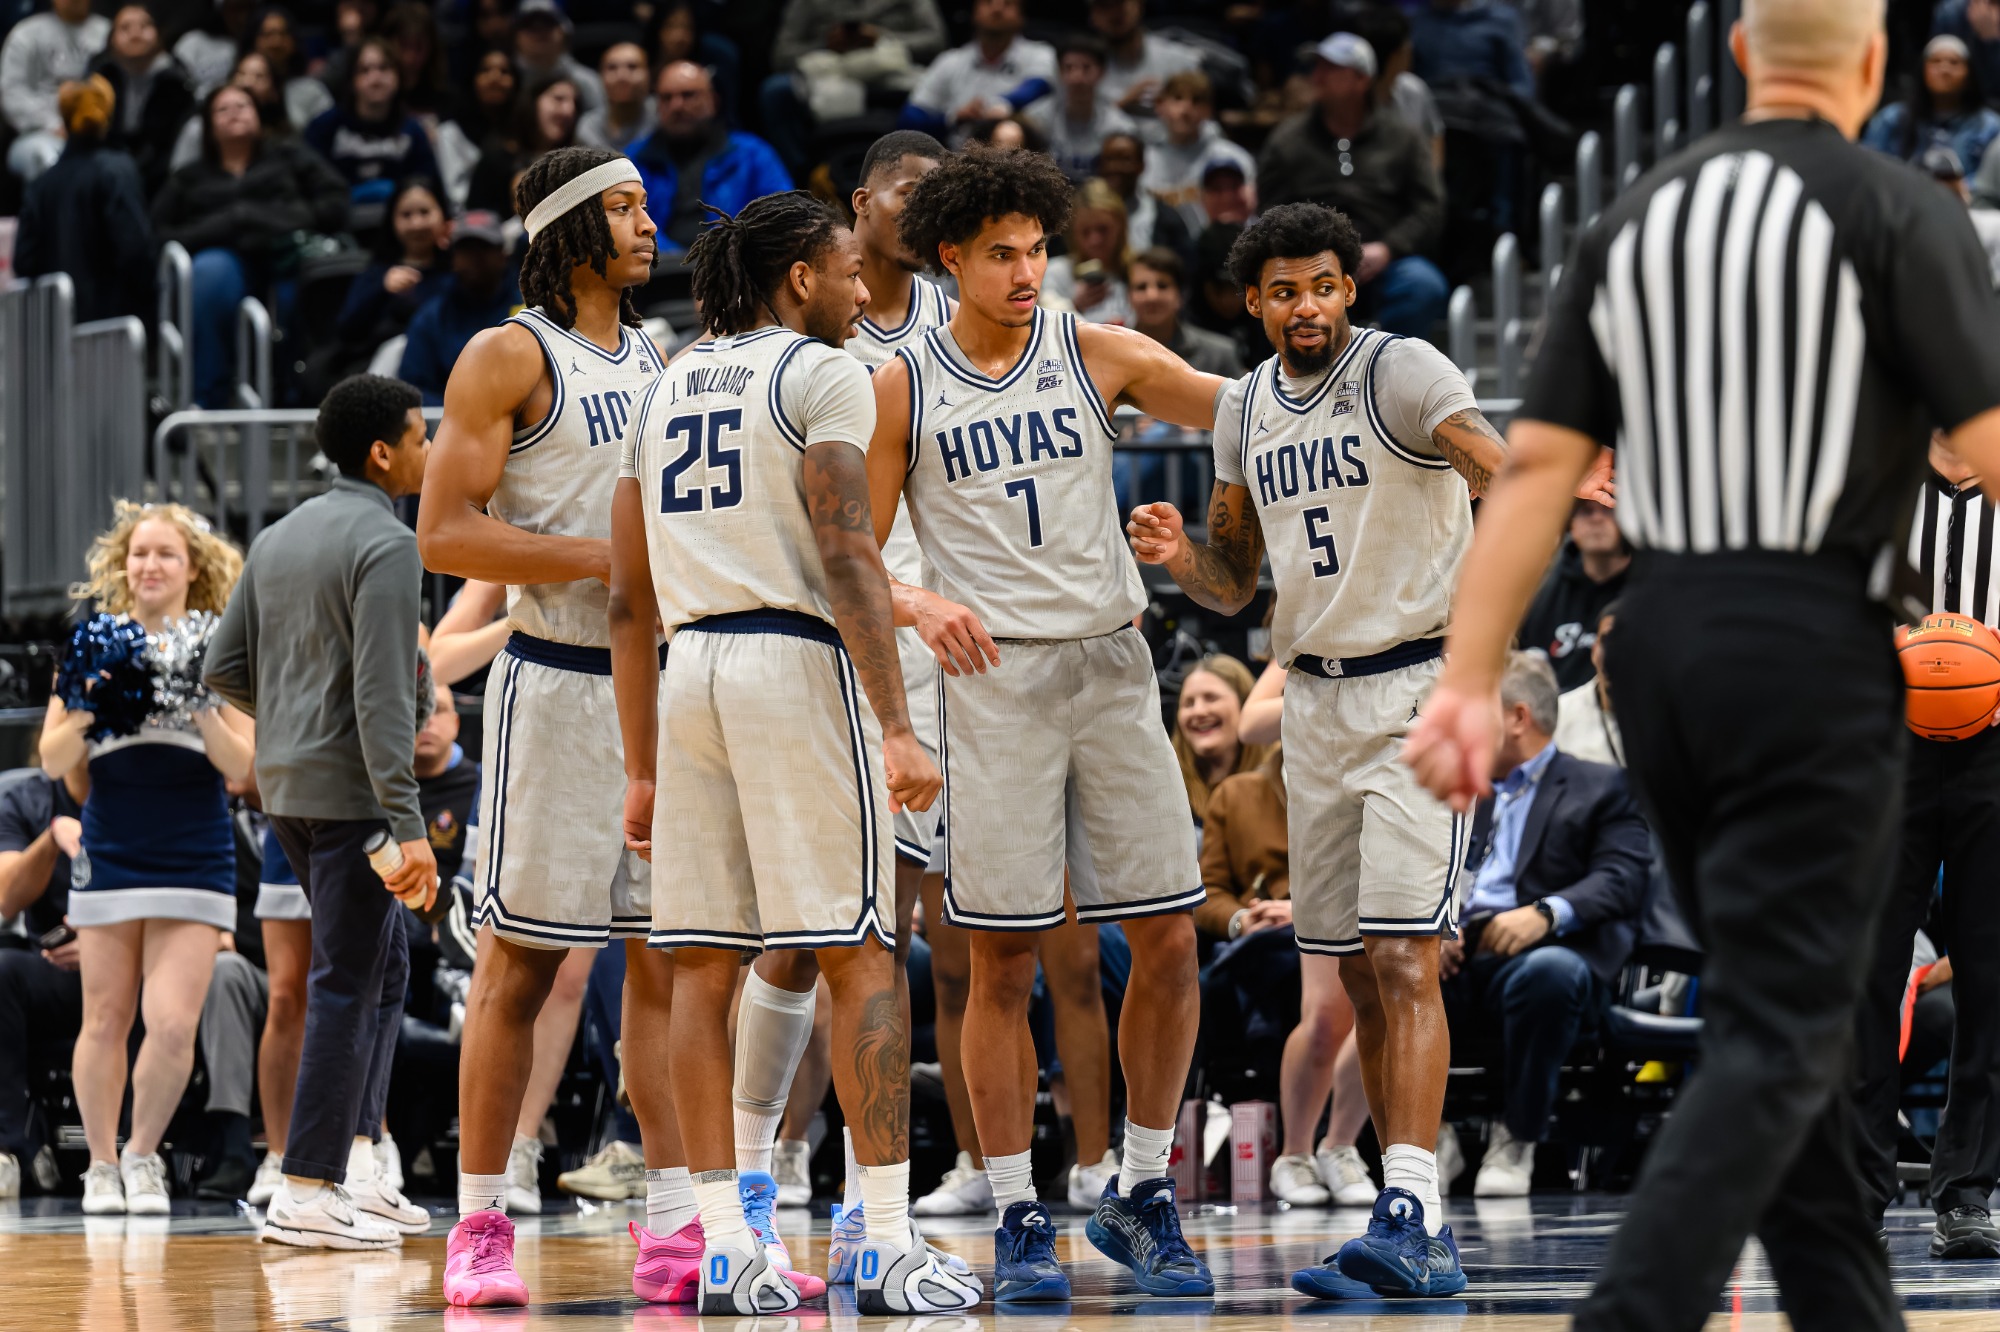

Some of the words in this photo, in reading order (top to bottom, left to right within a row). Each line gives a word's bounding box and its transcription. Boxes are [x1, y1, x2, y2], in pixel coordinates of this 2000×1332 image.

[670, 381, 679, 406] J.
[687, 365, 754, 397] WILLIAMS
[1036, 380, 1064, 390] EAST
[1038, 375, 1057, 384] BIG
[659, 407, 744, 515] 25
[935, 407, 1084, 484] HOYAS
[1255, 434, 1370, 507] HOYAS
[1002, 476, 1043, 550] 7
[1300, 505, 1341, 579] 5
[1321, 657, 1344, 677] G
